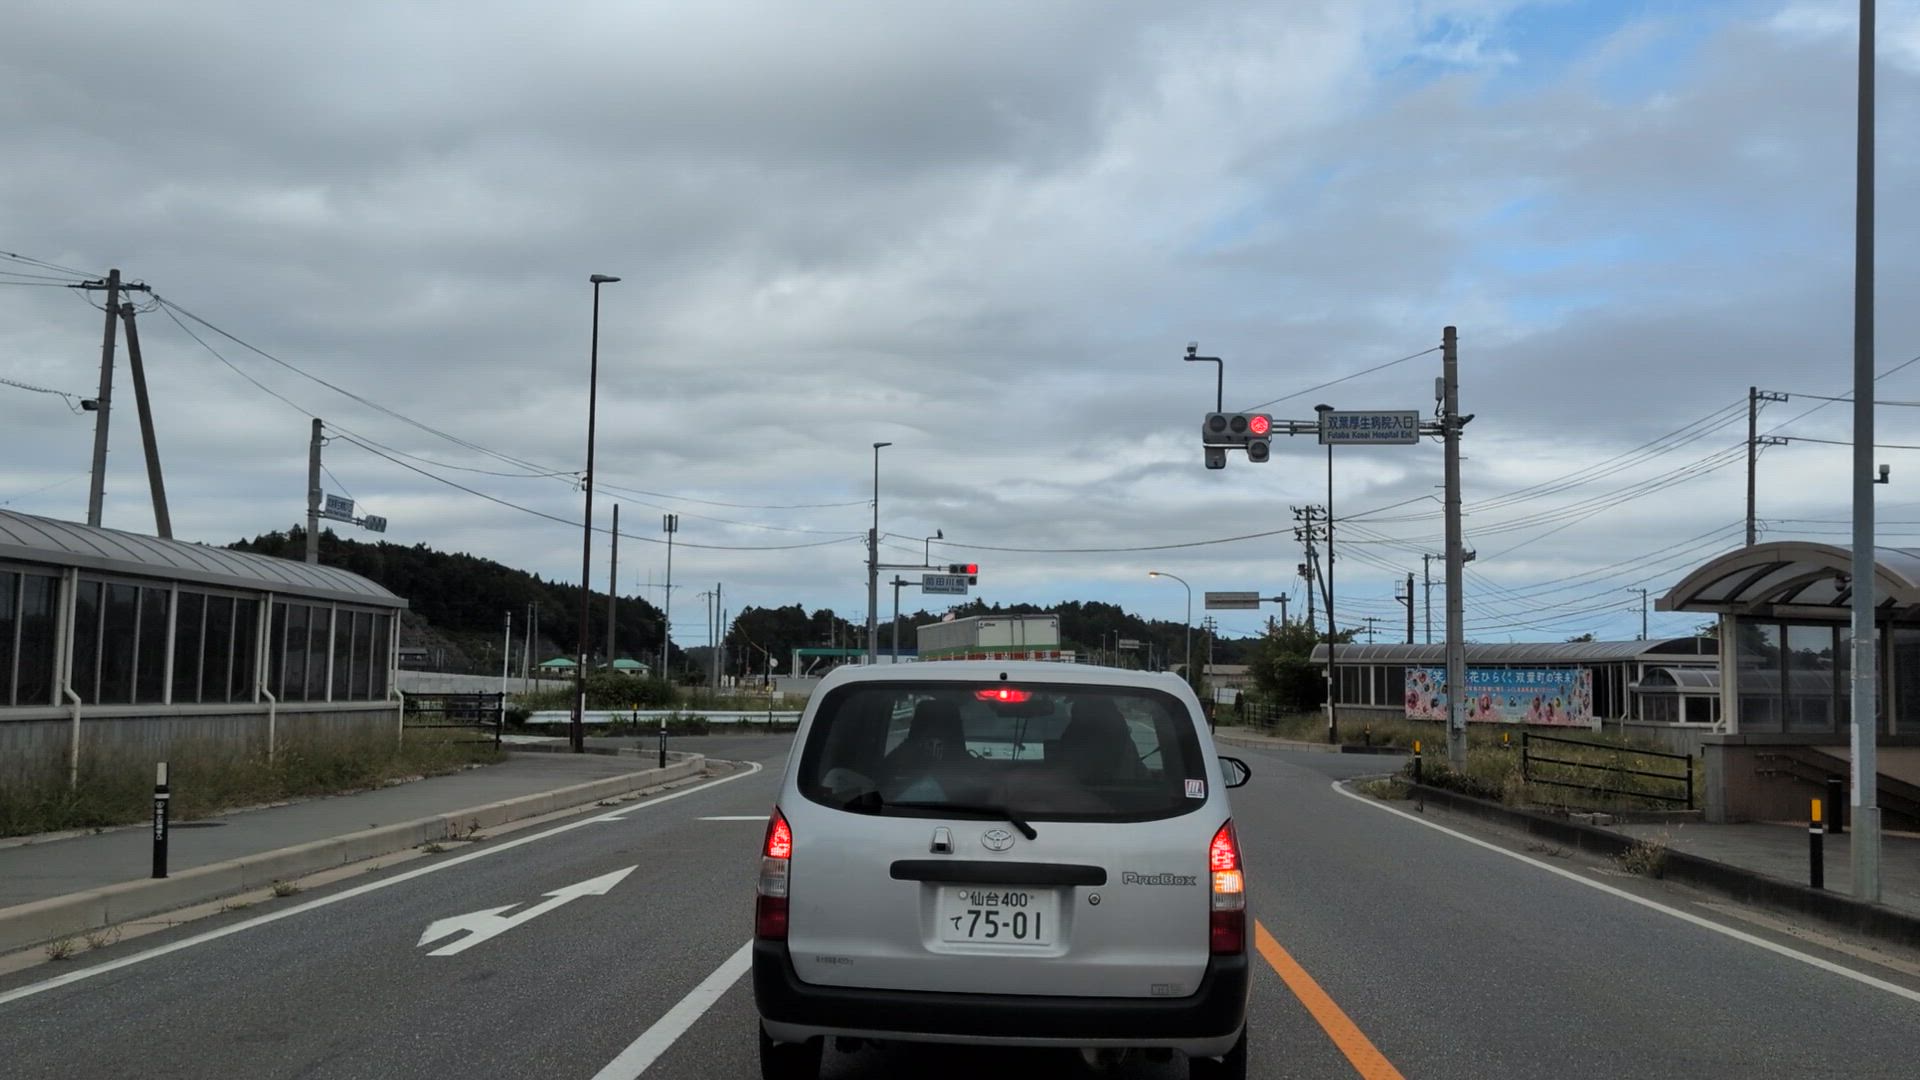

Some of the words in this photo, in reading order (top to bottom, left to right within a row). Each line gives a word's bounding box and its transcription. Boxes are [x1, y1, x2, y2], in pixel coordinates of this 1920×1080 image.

[1327, 415, 1413, 430] 双葉厚生病院入口
[1372, 431, 1398, 440] Hospital
[967, 909, 1041, 940] 75-01
